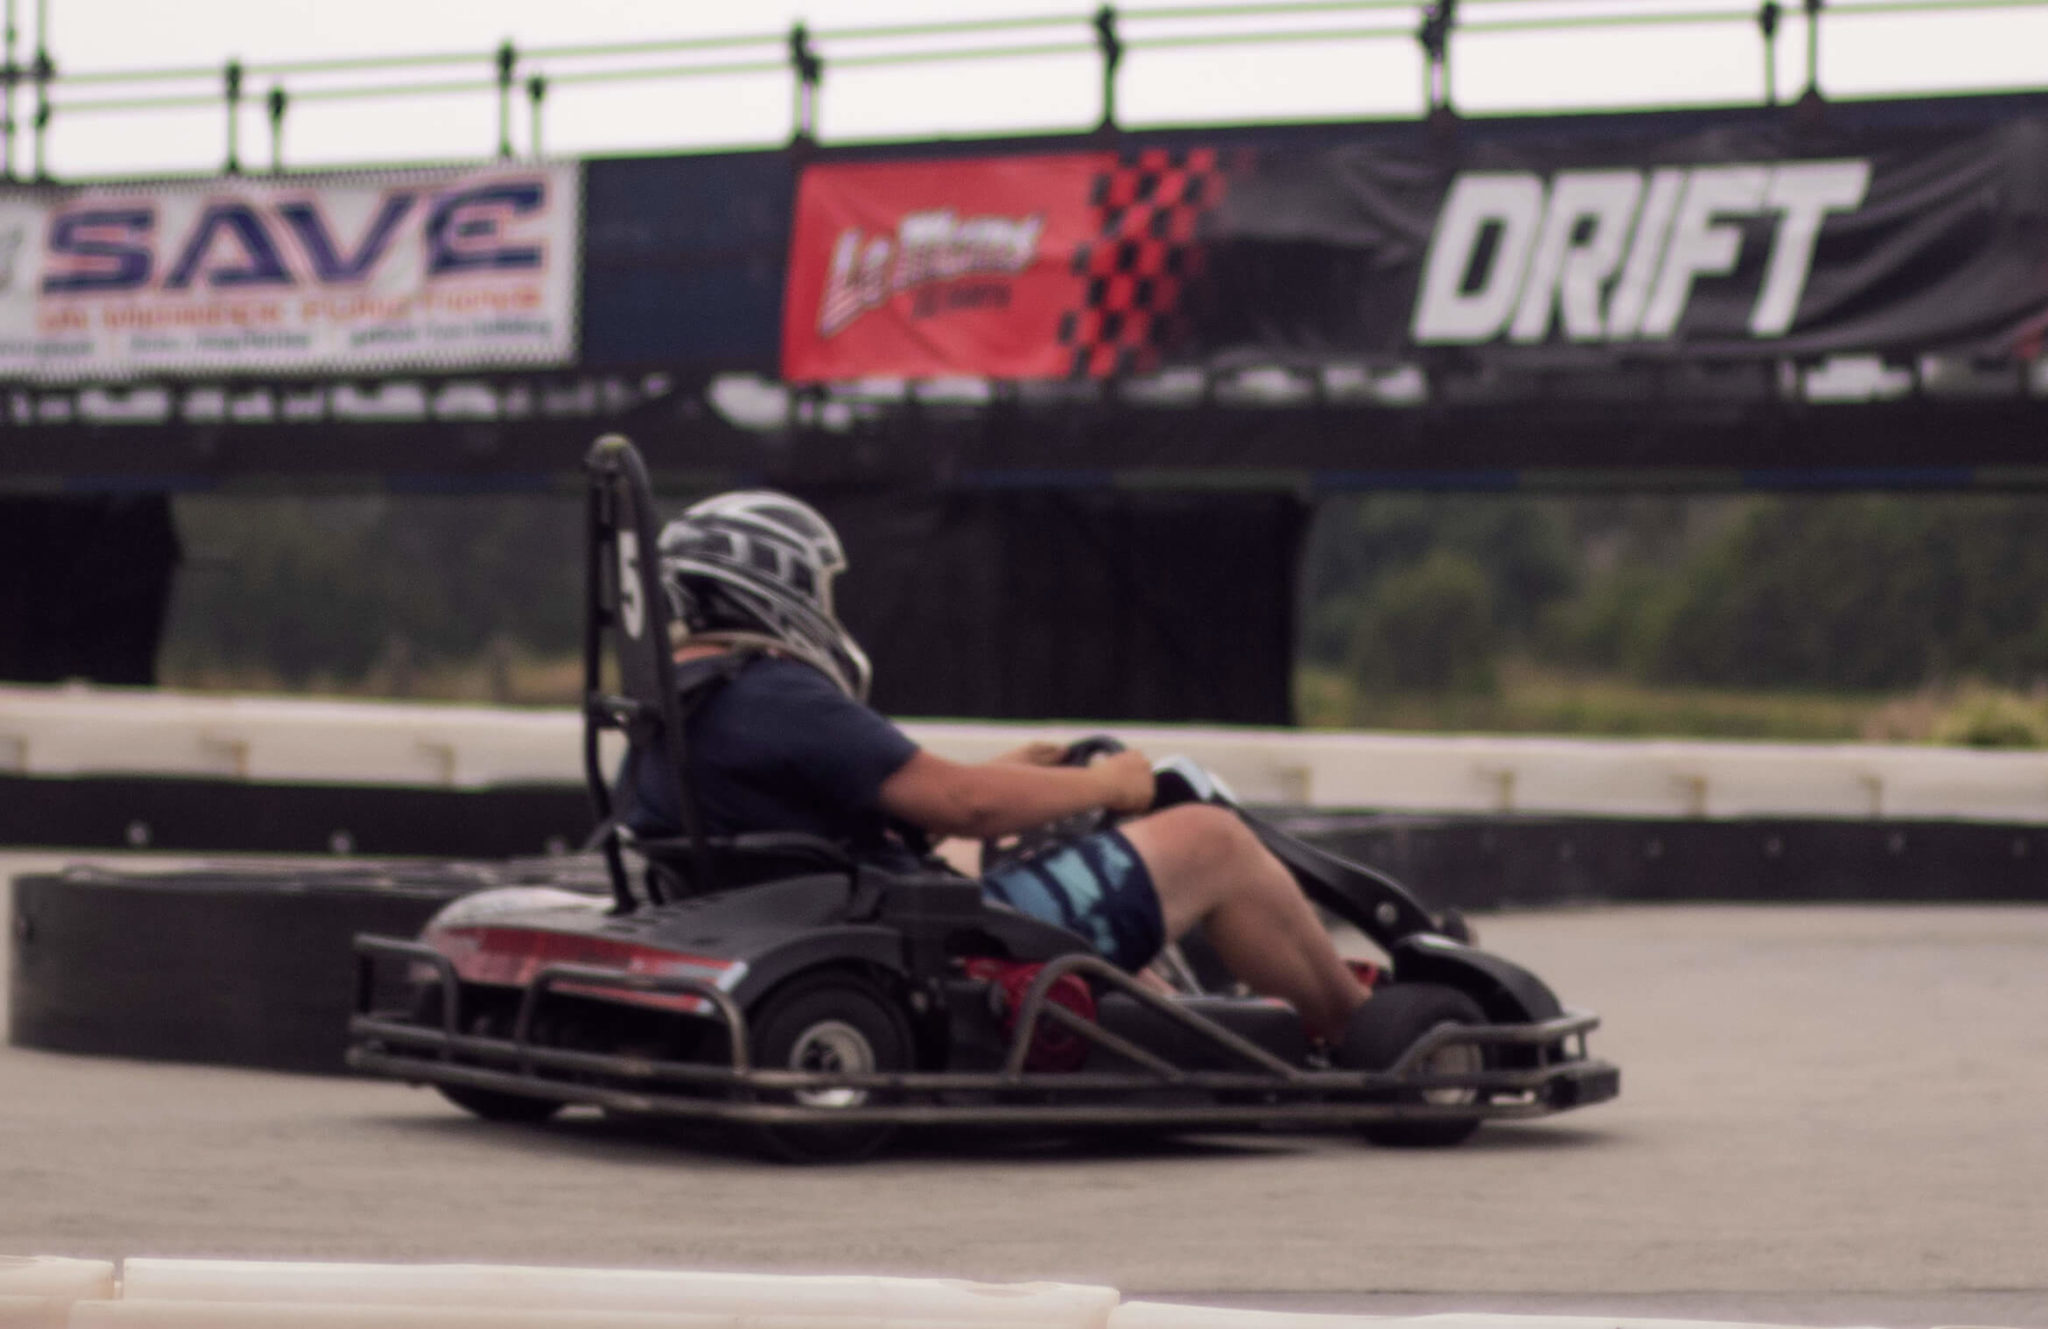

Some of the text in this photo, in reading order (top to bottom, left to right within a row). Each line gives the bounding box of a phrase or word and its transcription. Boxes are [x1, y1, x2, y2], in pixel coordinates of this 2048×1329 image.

[43, 178, 547, 295] SAVE
[1412, 161, 1871, 343] DRIFT
[617, 530, 645, 640] 5
